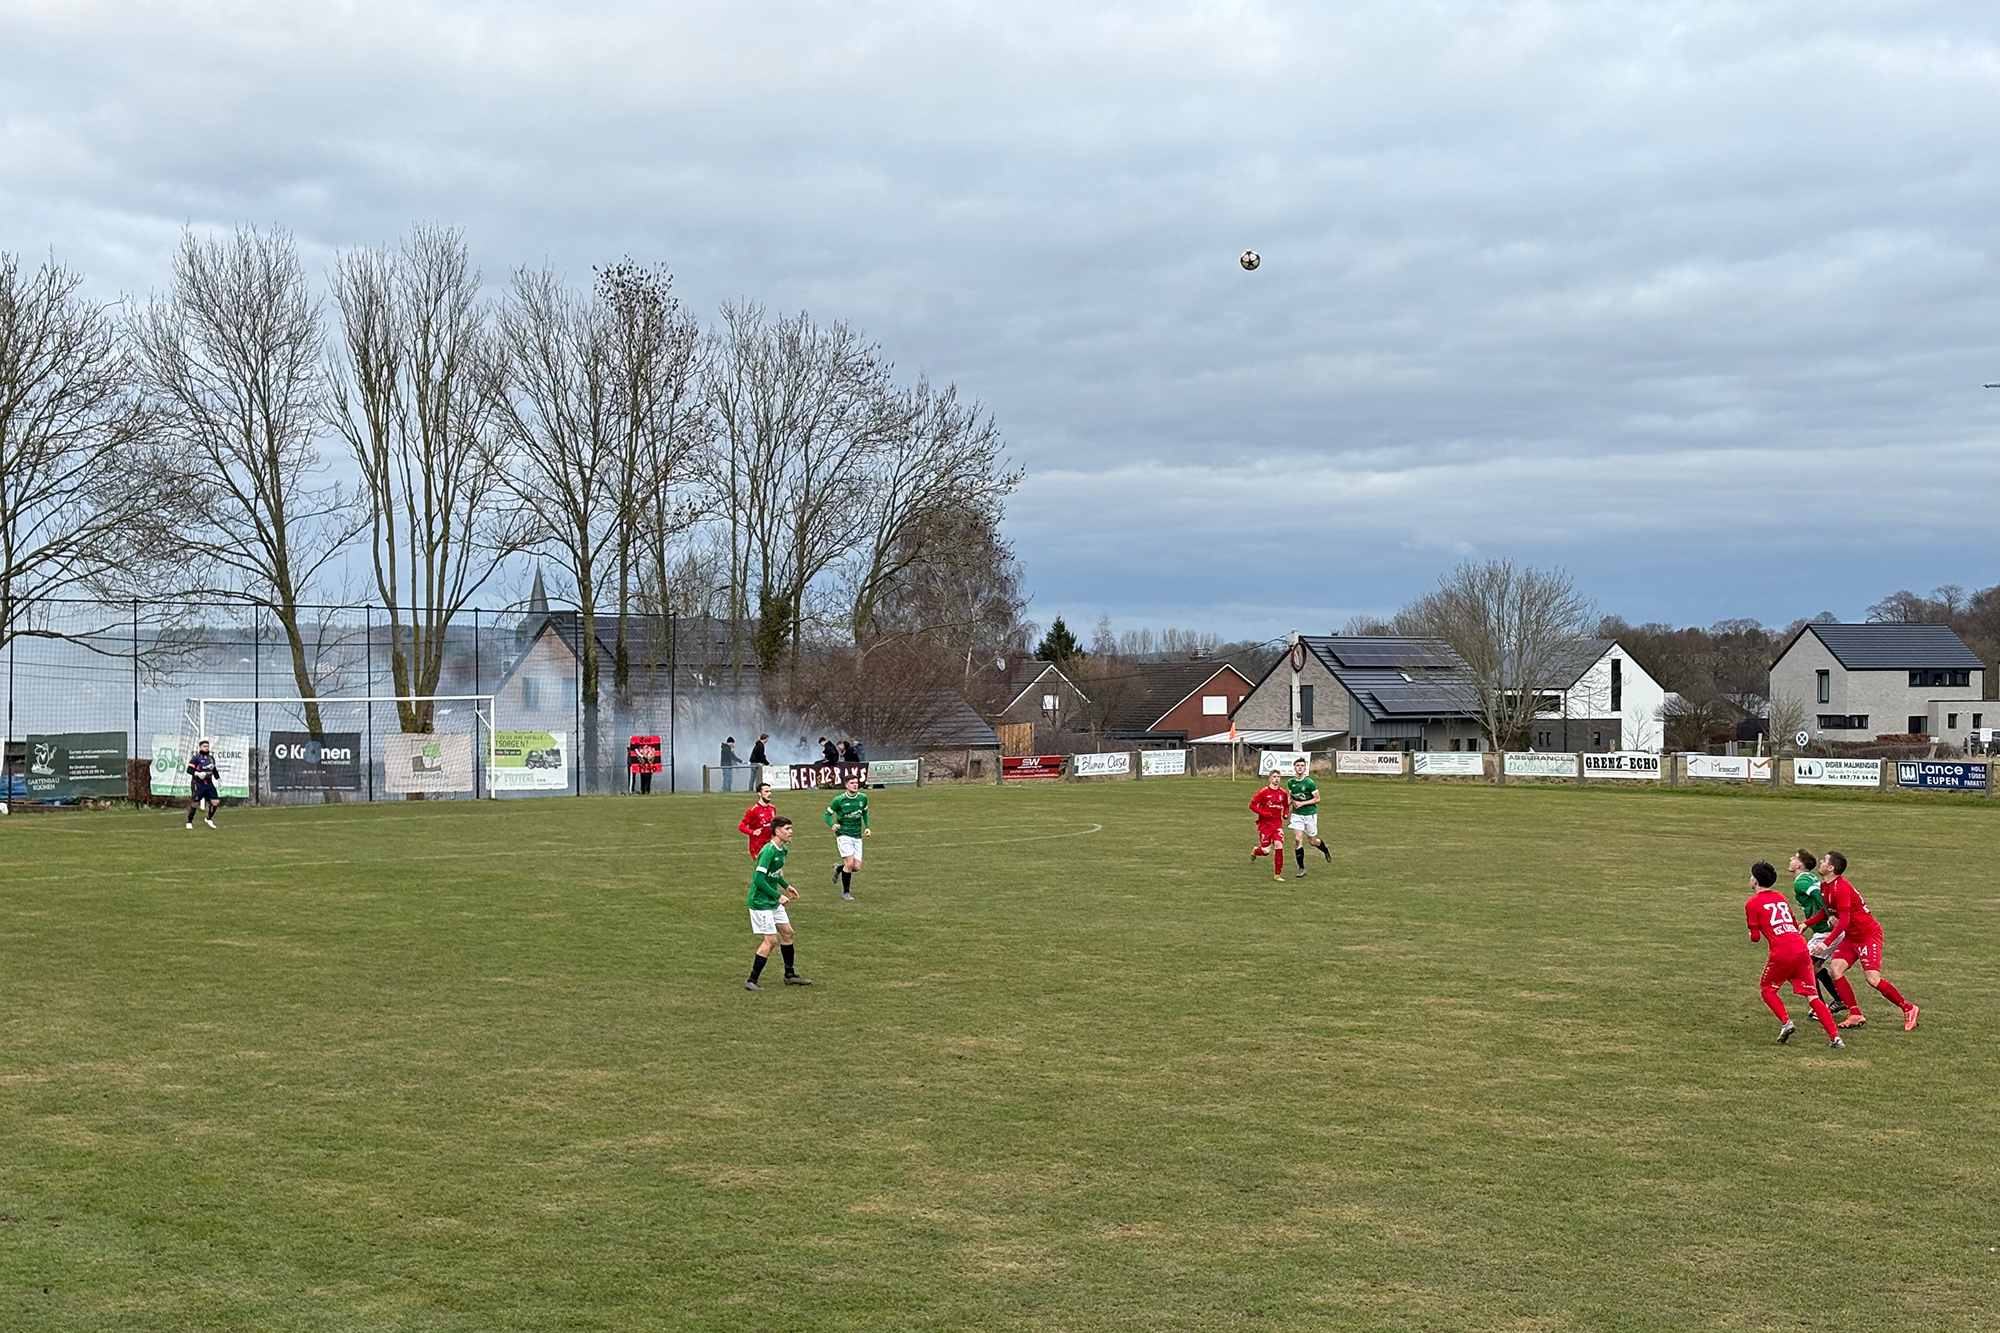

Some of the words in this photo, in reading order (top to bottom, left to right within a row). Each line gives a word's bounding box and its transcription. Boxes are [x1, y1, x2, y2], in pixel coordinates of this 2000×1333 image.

[275, 743, 288, 760] G
[1021, 757, 1041, 766] SW
[1377, 756, 1400, 764] KOHL
[1585, 756, 1659, 770] GRENZ-ECHO
[1825, 761, 1843, 769] DIDIER
[1918, 762, 1964, 776] Lance
[1970, 765, 1986, 773] HOLZ
[27, 777, 60, 785] GARTENBAU
[790, 767, 817, 790] RED
[819, 766, 832, 784] 12
[1926, 776, 1960, 786] EUPEN
[1763, 901, 1794, 927] 28
